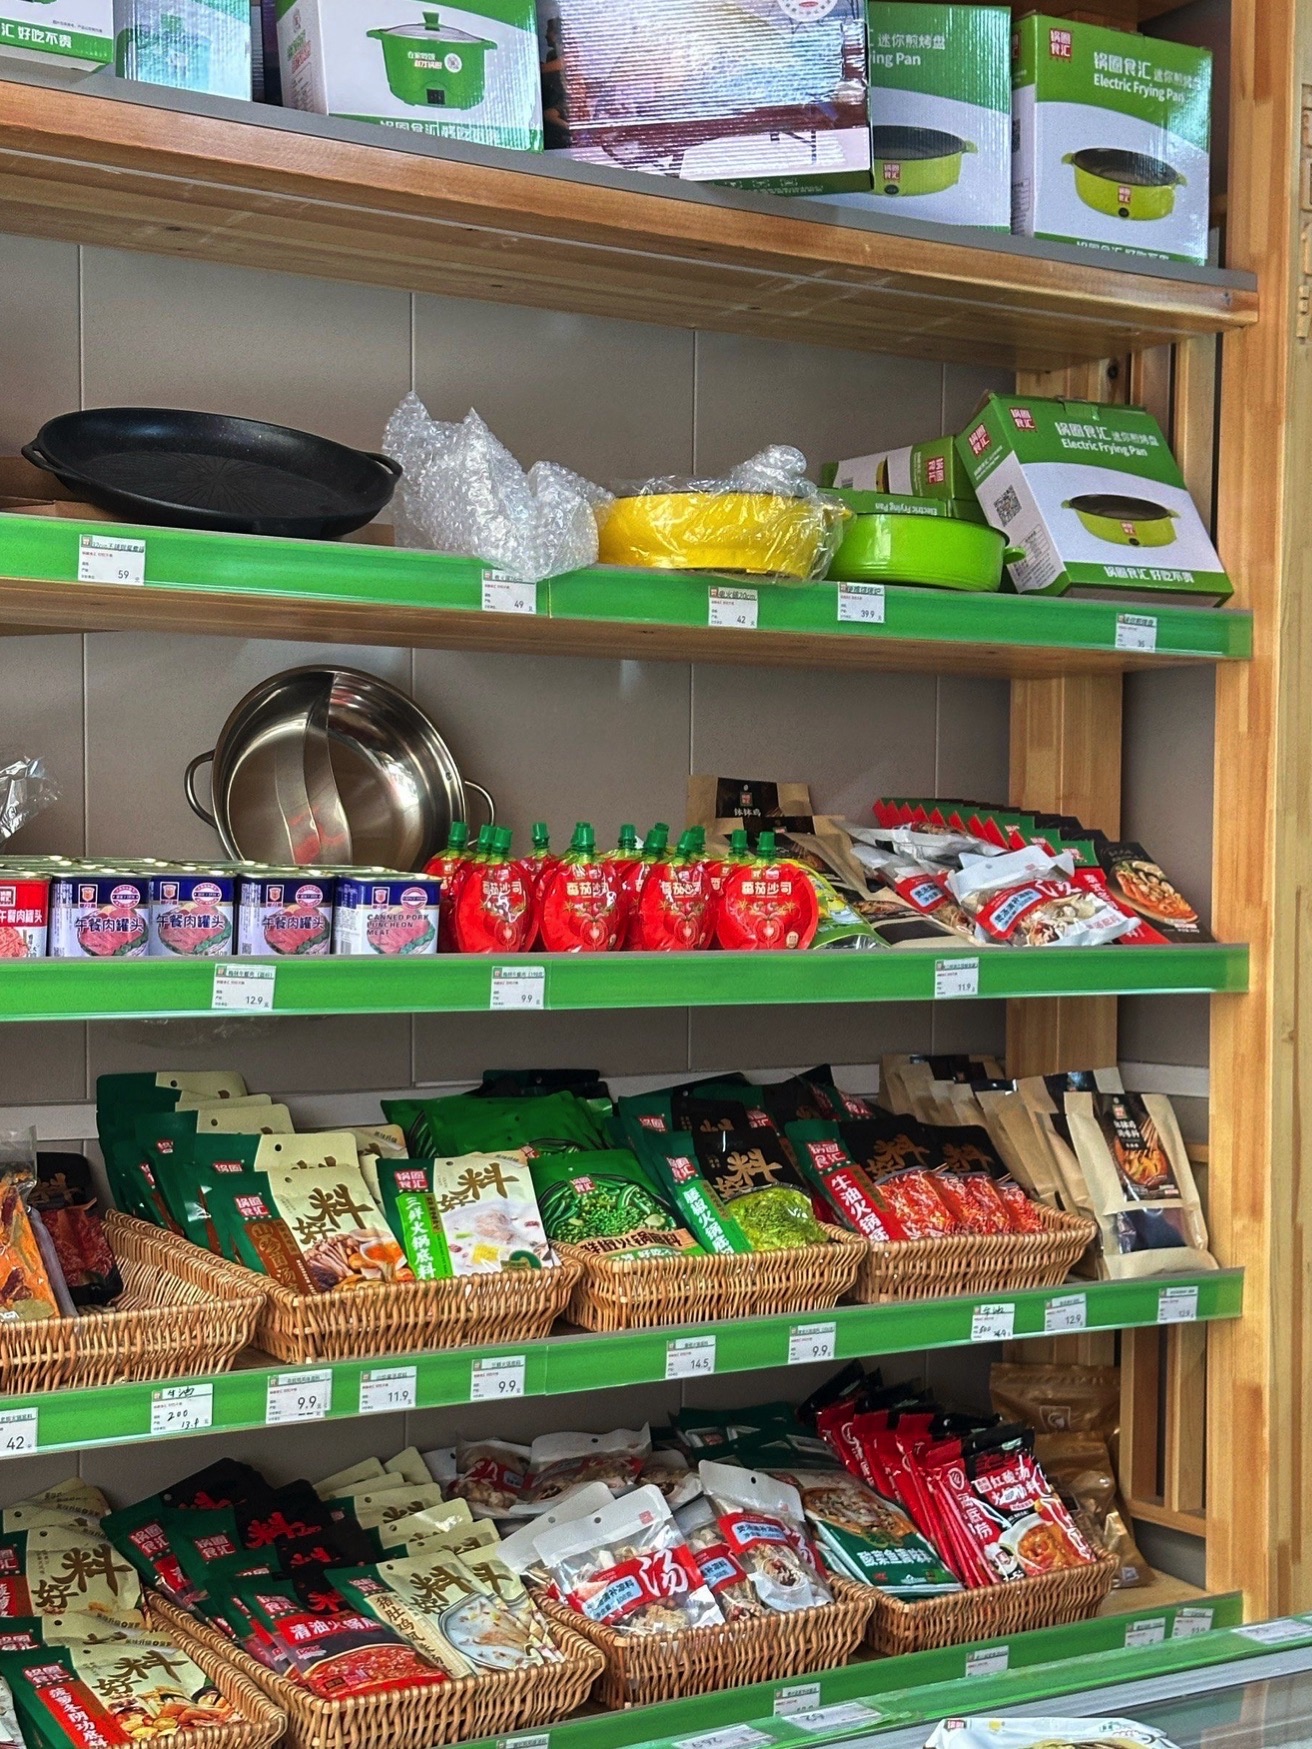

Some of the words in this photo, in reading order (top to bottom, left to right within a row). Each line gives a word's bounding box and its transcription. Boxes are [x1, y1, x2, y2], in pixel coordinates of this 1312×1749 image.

[17, 26, 72, 49] 好吃不贵
[878, 32, 946, 50] 迷你煎烤盘
[895, 51, 921, 65] Pan
[1093, 52, 1151, 80] 锅圈食汇
[1093, 74, 1132, 94] Electric
[1133, 81, 1166, 102] Frying
[1166, 86, 1185, 102] Pan
[1054, 422, 1109, 442] 锅圈食汇
[1061, 438, 1097, 452] Electric
[1098, 441, 1123, 457] Frying
[1124, 445, 1148, 457] Pan
[118, 570, 130, 579] 59
[1104, 565, 1149, 580] 锅圈食汇
[514, 600, 524, 609] 49
[737, 615, 746, 624] 42
[741, 881, 792, 896] 番茄沙司
[75, 917, 144, 933] 午餐肉罐头
[156, 914, 225, 929] 午餐肉罐头
[262, 916, 325, 931] 午餐肉罐头
[367, 914, 405, 922] CANNED
[406, 914, 429, 922] PORK
[367, 928, 390, 936] MEAT
[246, 996, 264, 1005] 12.9
[405, 1196, 436, 1280] 三鲜火锅底料
[812, 1345, 828, 1357] 9.9
[690, 1358, 709, 1370] 14.5
[498, 1380, 516, 1394] 9.9
[297, 1395, 317, 1410] 9.9
[388, 1390, 409, 1403] 11.9
[167, 1409, 188, 1422] 200
[6, 1436, 25, 1450] 42
